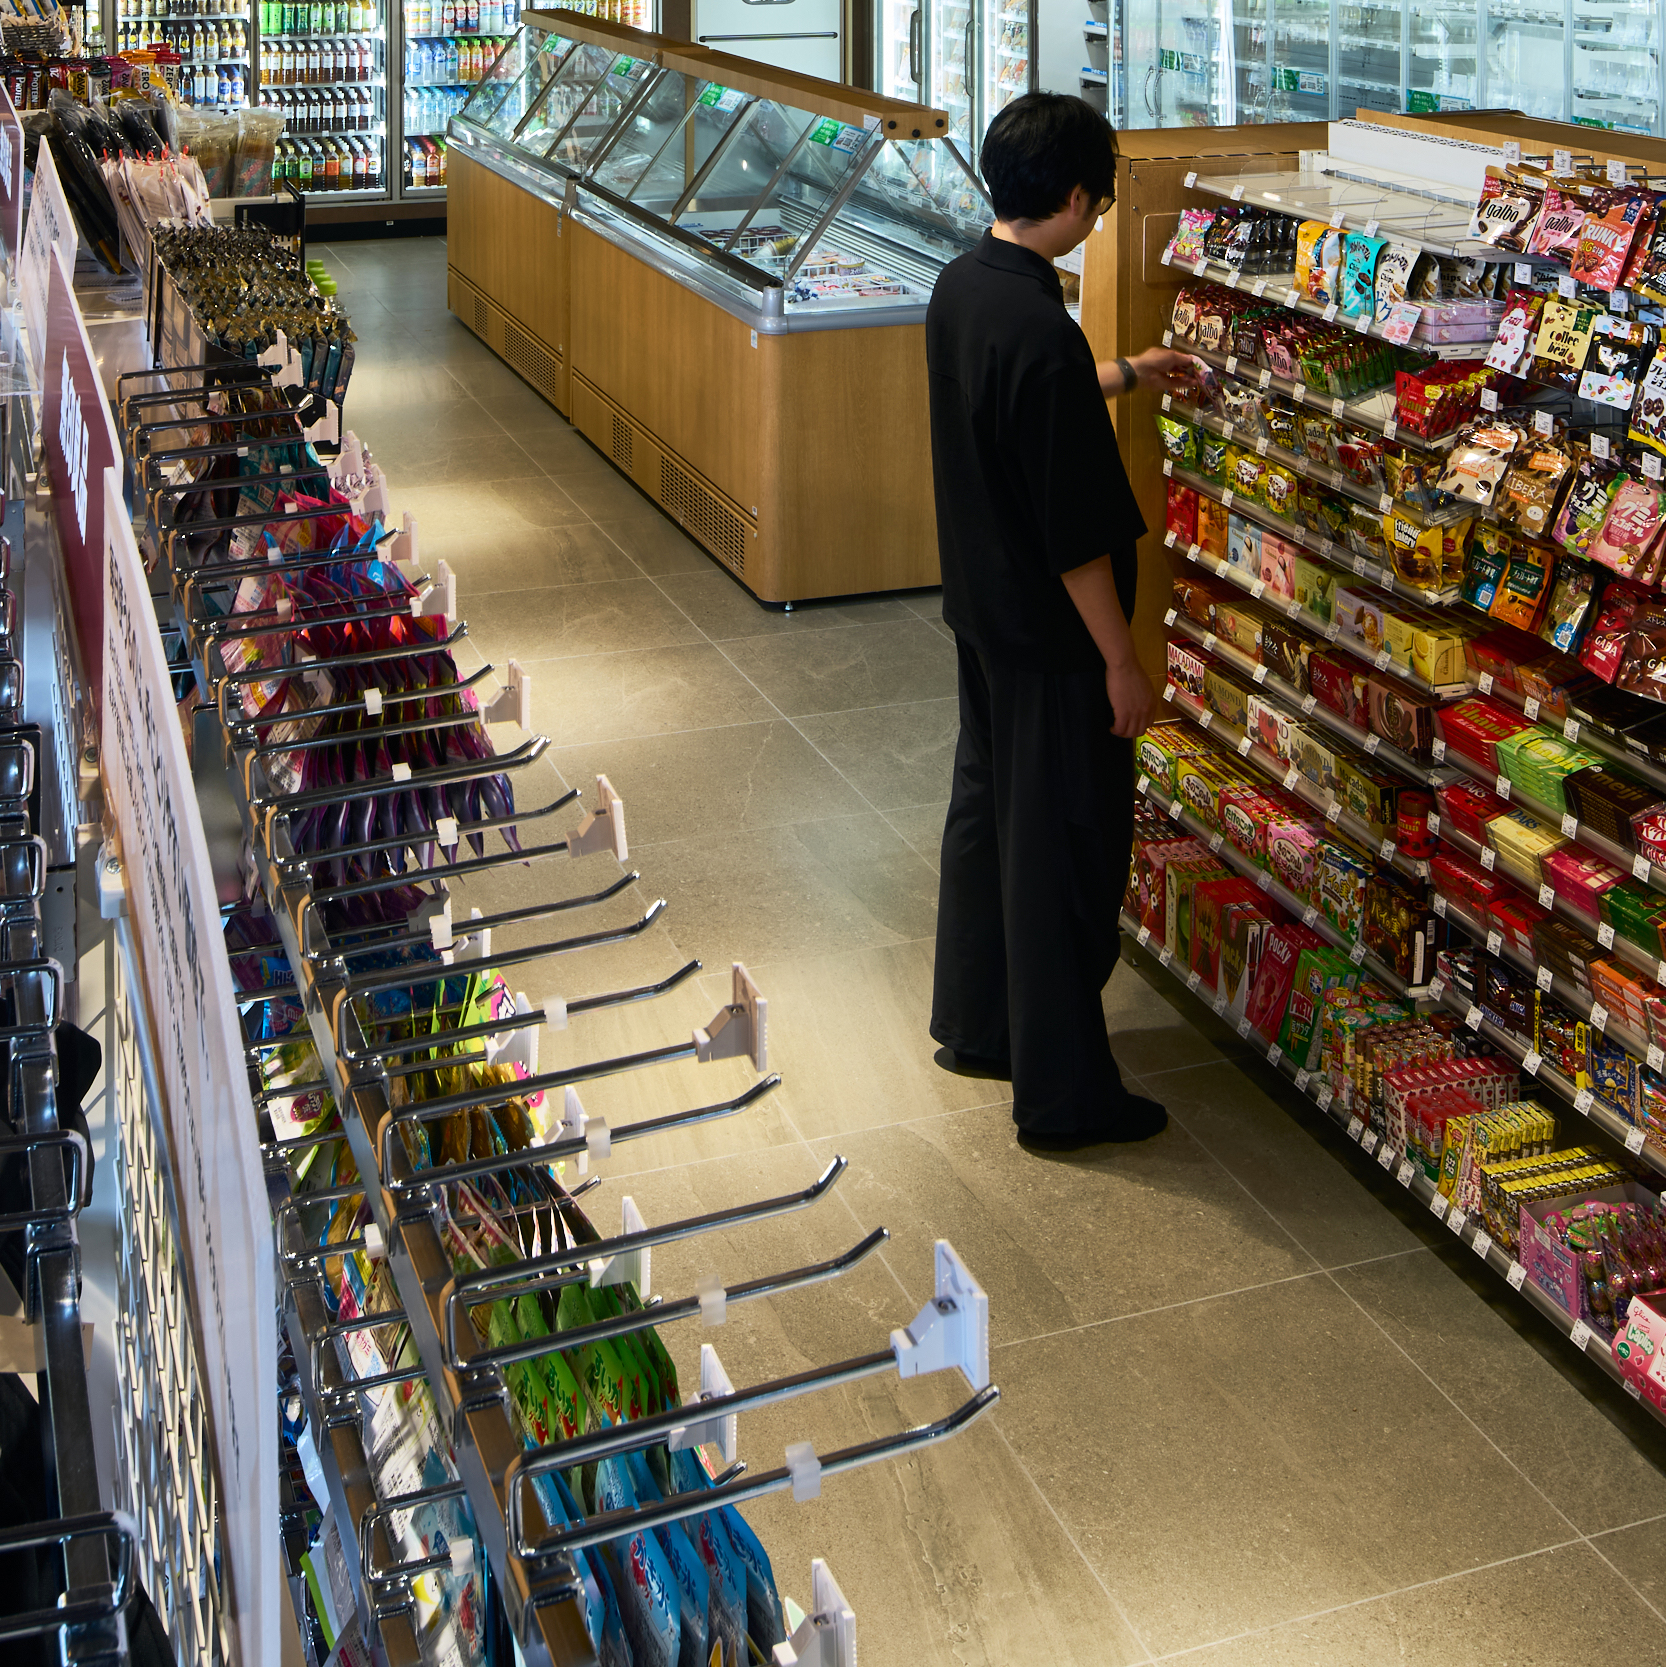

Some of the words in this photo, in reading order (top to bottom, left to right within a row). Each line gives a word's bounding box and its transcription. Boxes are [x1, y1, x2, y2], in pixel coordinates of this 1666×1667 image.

[1485, 203, 1519, 223] galbo
[1544, 215, 1574, 234] galbo
[1453, 701, 1510, 738] Ghana
